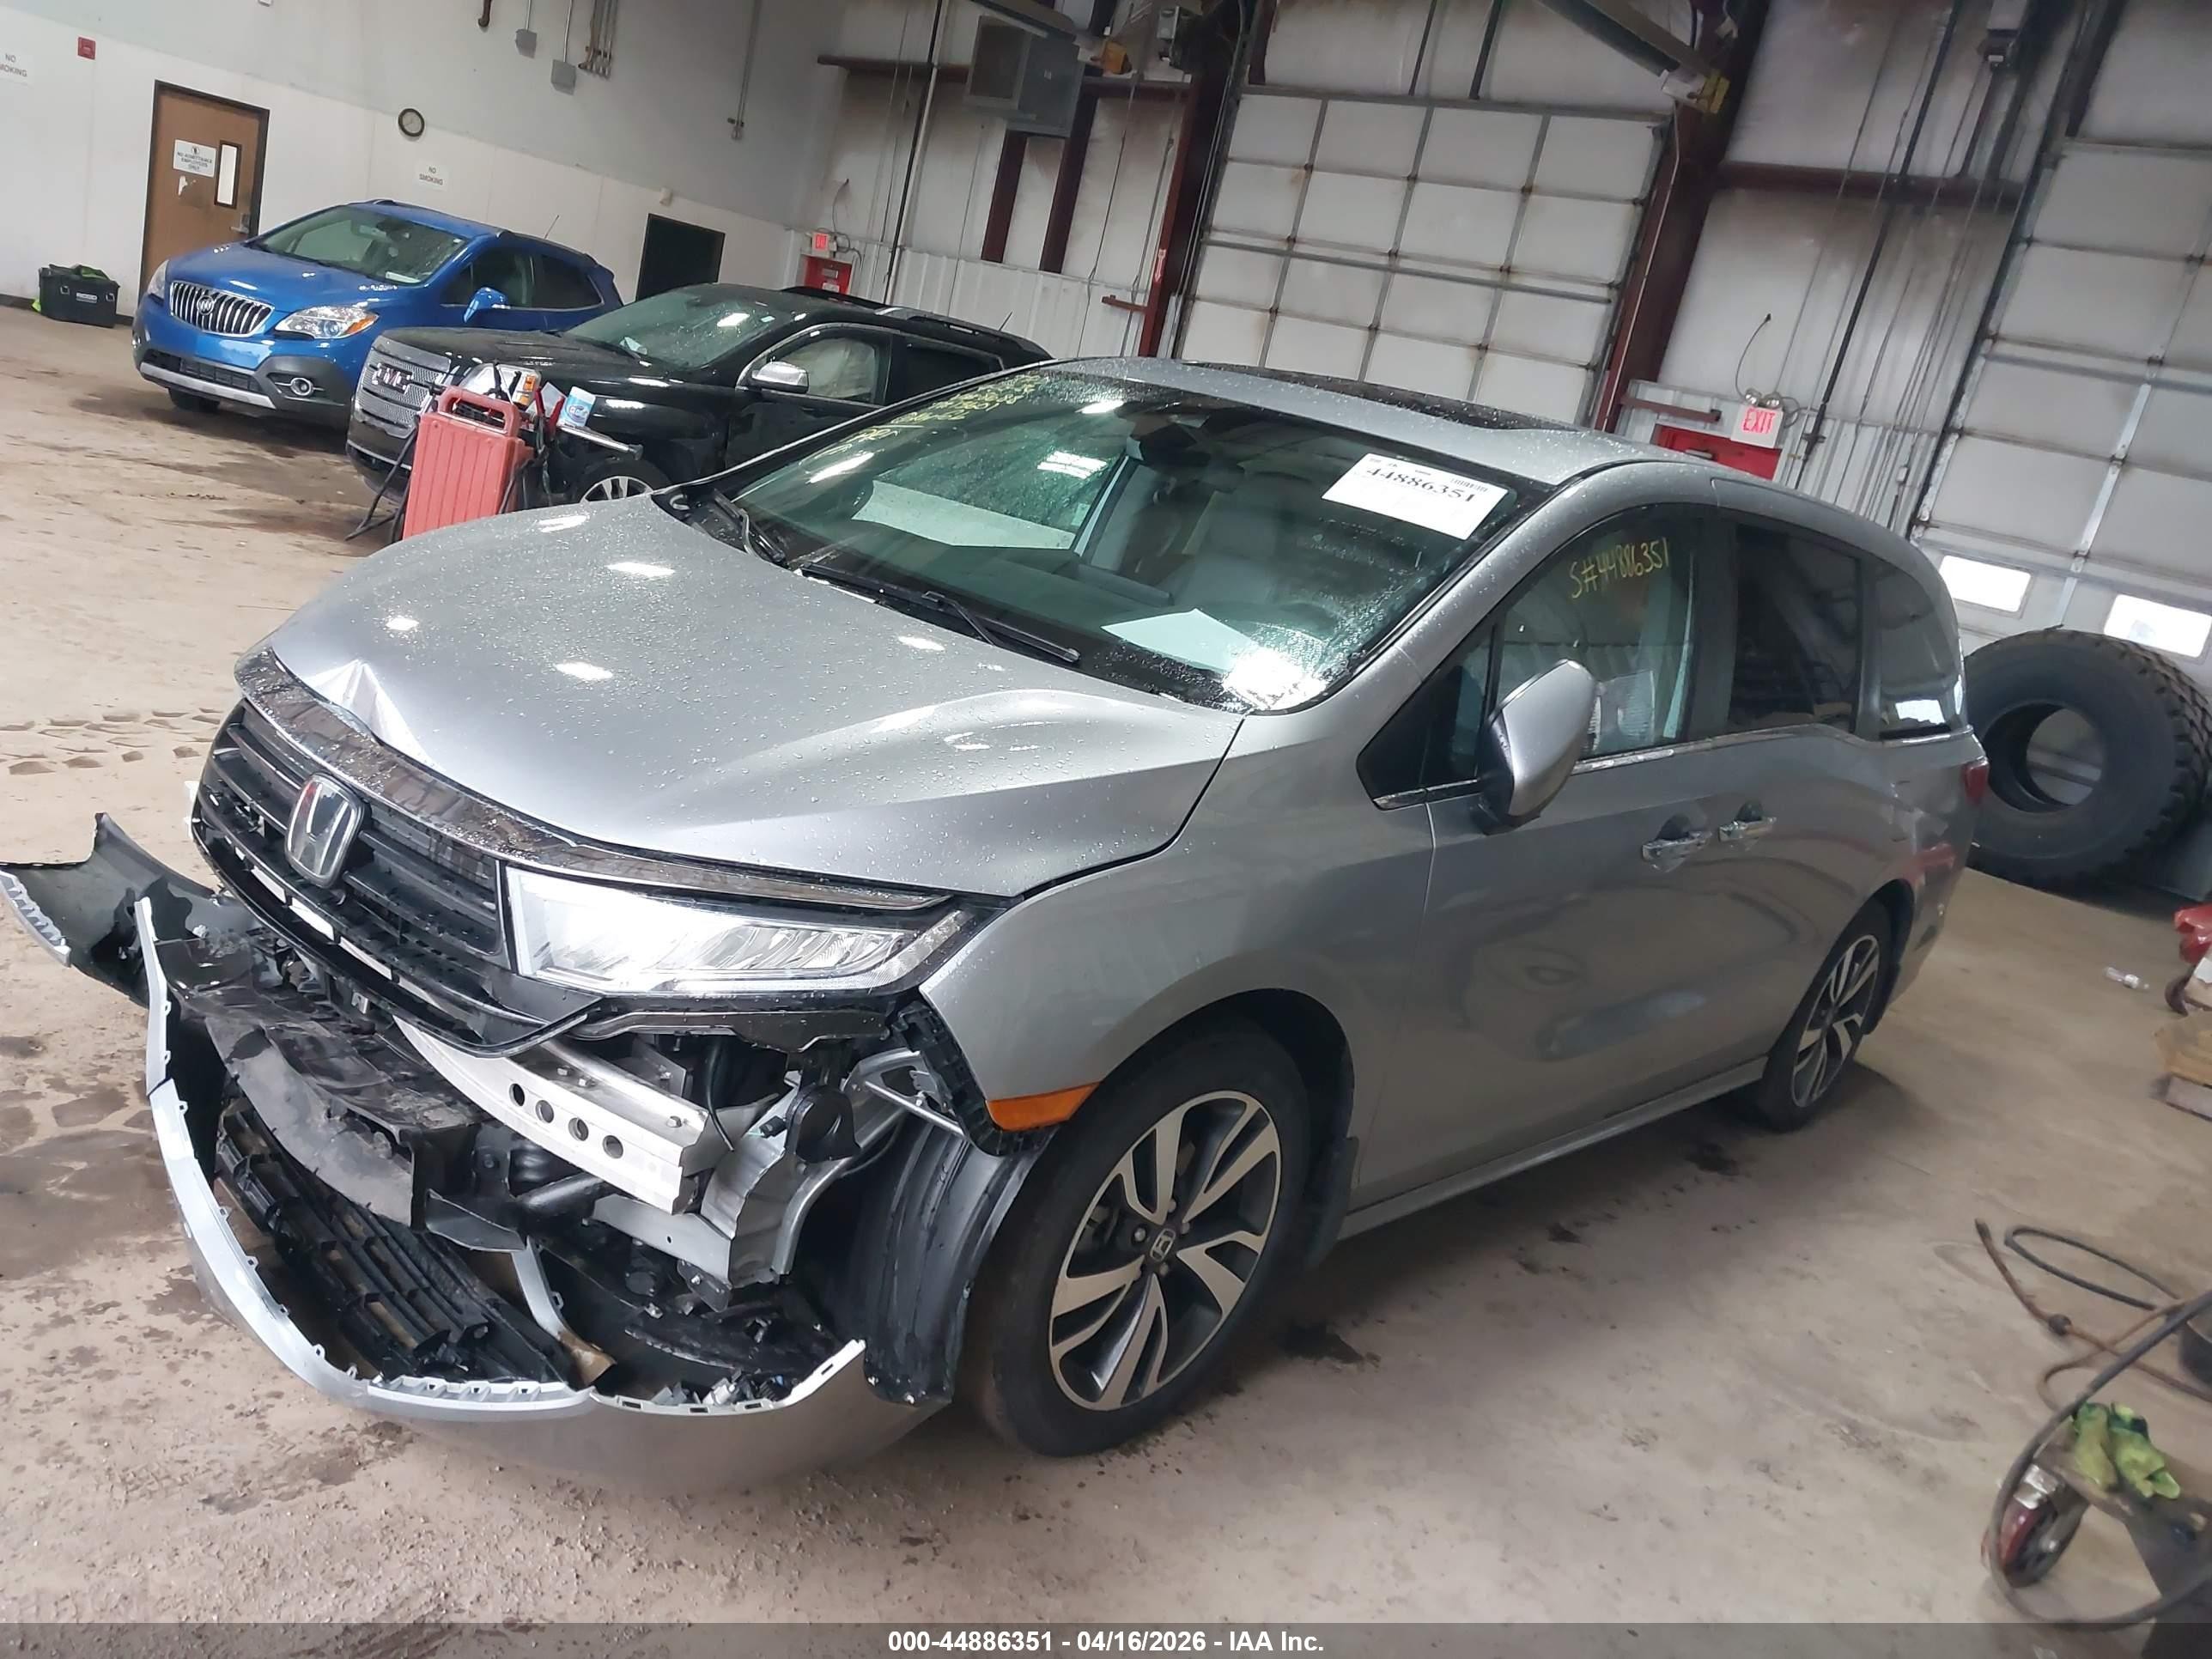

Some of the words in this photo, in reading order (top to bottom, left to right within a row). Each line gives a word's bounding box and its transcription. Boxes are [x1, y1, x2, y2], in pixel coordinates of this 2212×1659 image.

[5, 53, 16, 63] NO
[0, 64, 27, 77] MOKING
[419, 173, 443, 185] SMOKING
[1743, 407, 1775, 434] EXIT
[1366, 468, 1474, 501] 44886351
